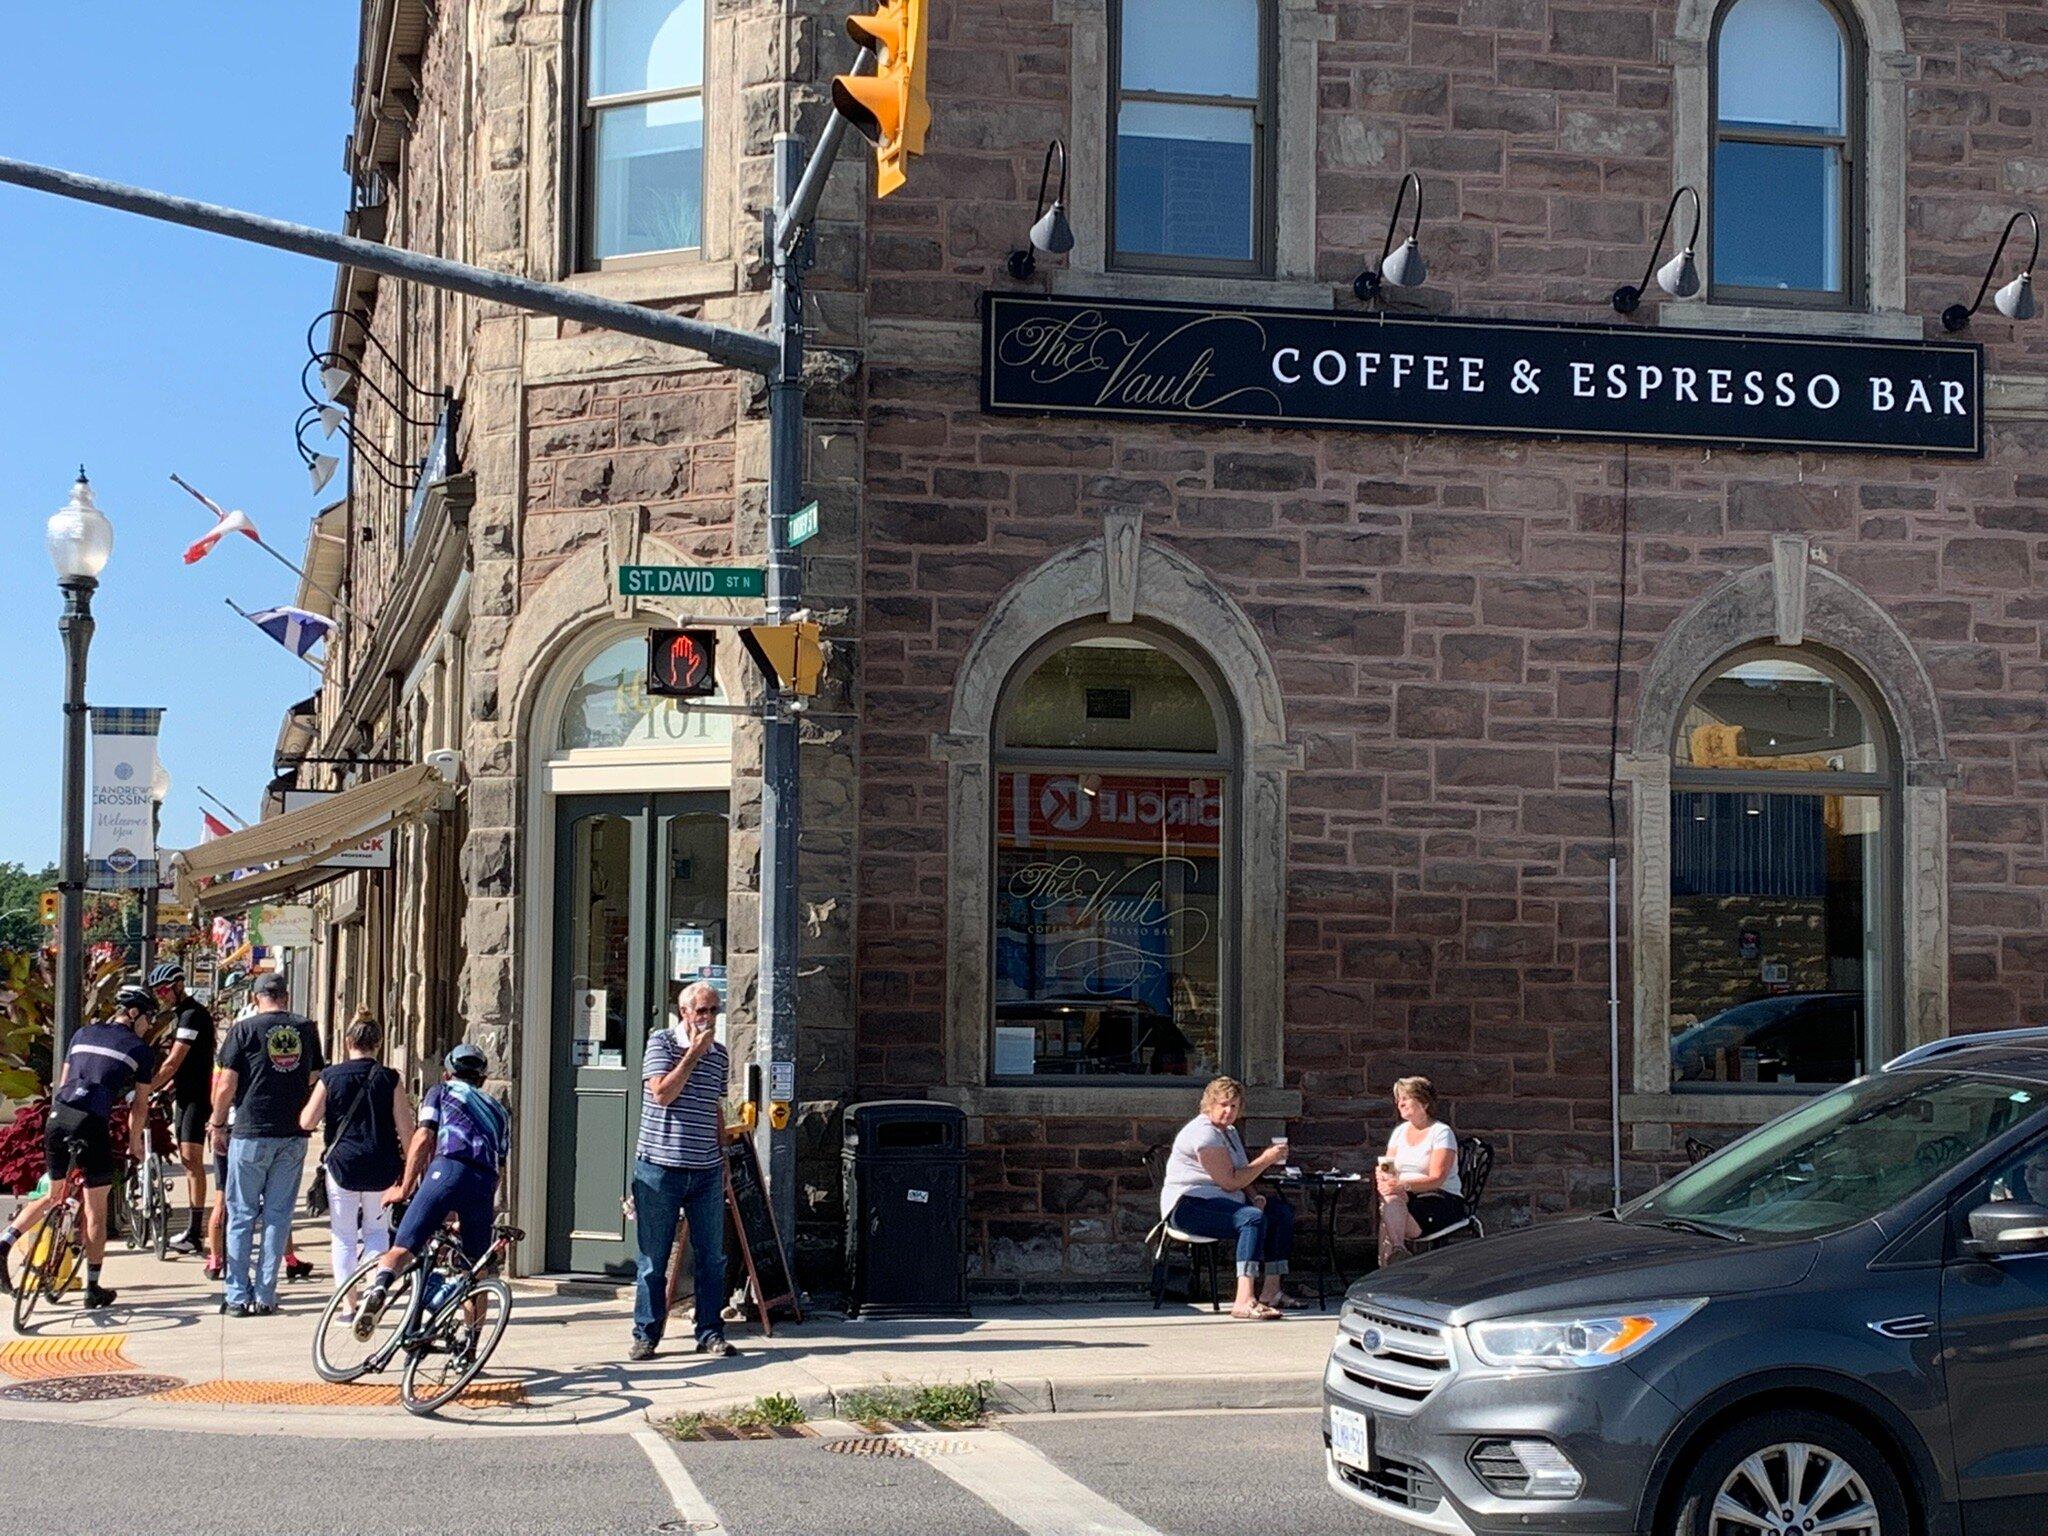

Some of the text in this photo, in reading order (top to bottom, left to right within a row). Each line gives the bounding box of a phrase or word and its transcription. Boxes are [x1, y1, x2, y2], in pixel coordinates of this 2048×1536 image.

[998, 309, 1267, 411] The Vault
[1271, 347, 1967, 417] COFFEE & ESPRESSO BAR
[726, 576, 740, 588] ST
[743, 577, 751, 588] N
[1008, 856, 1205, 935] The Vault
[1153, 927, 1175, 937] BAR
